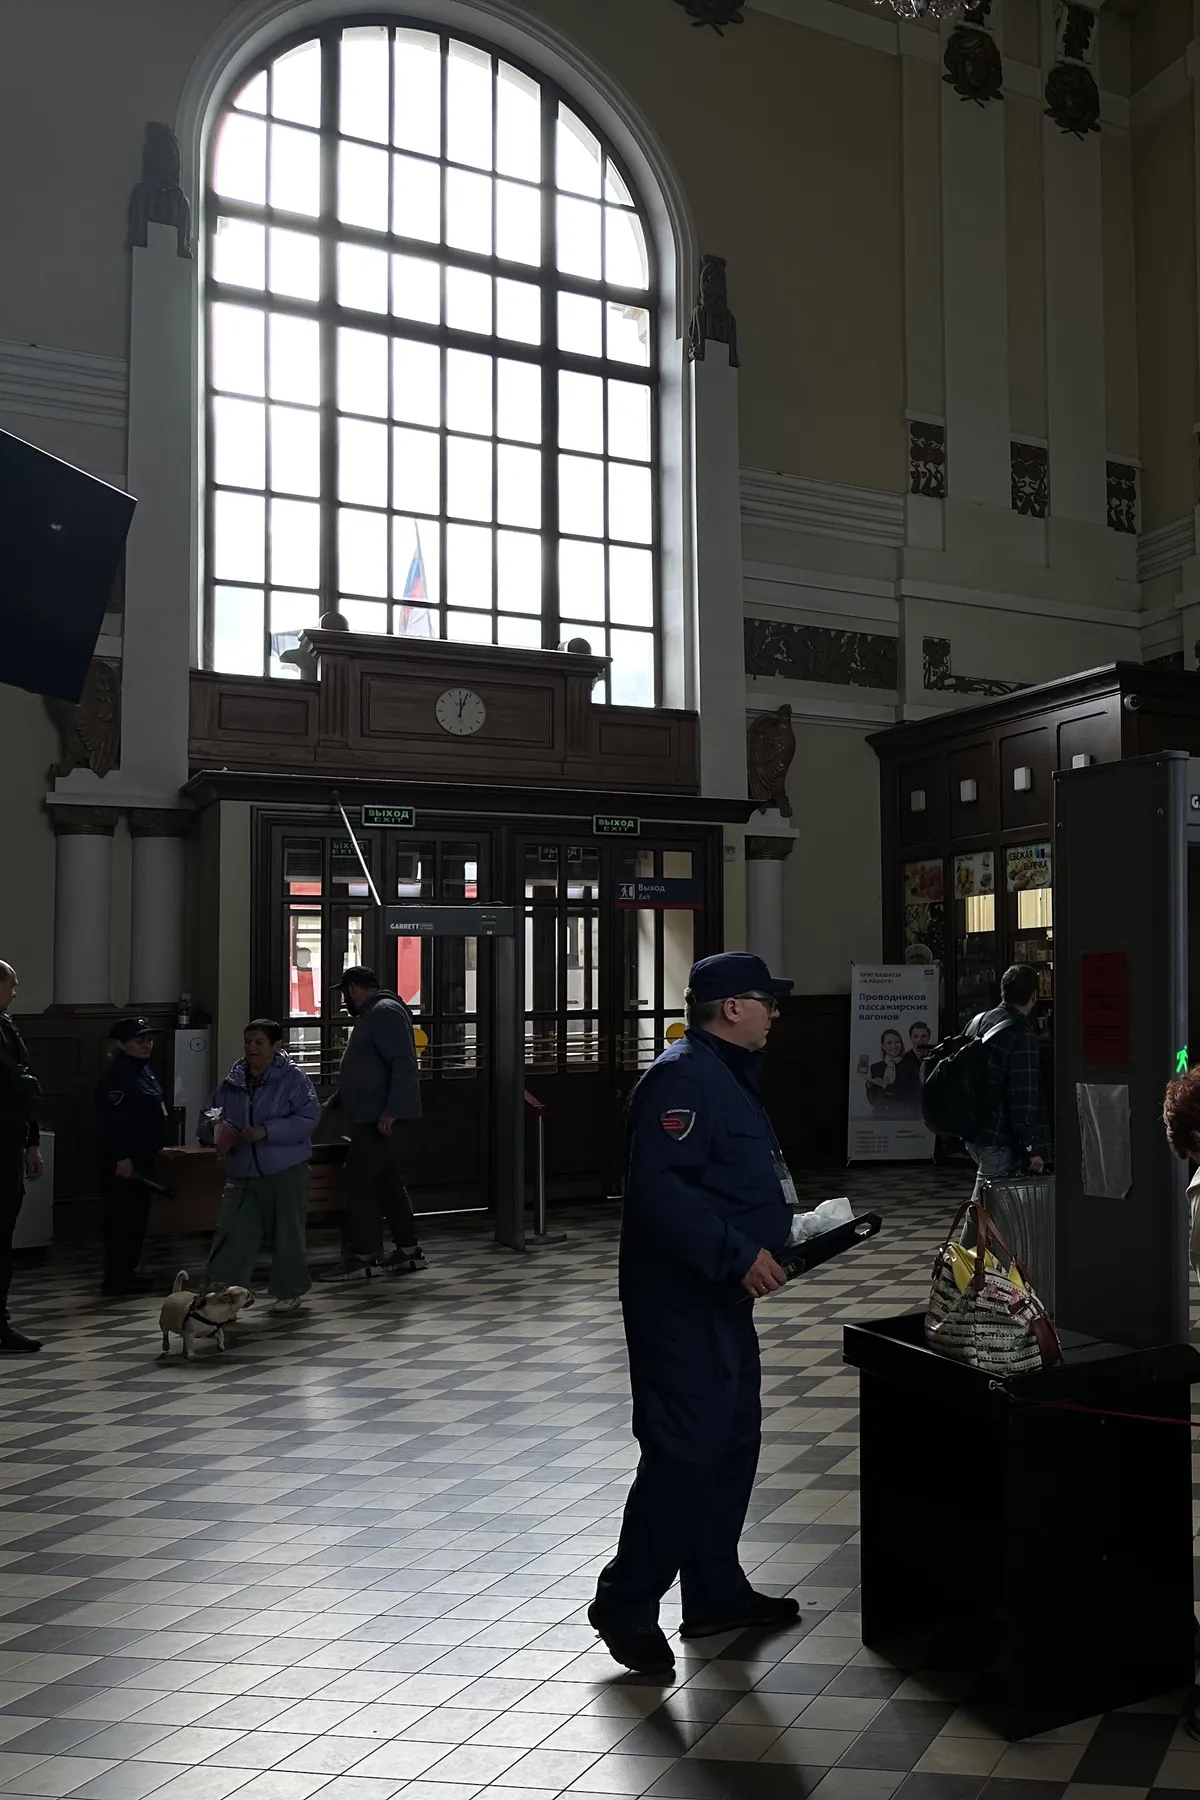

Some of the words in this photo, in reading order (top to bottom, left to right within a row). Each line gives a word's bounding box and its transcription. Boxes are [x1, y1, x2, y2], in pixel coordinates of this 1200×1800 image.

[368, 809, 410, 819] ВЫХОД
[598, 818, 635, 828] ВЫХОД
[1009, 850, 1033, 862] СВЕЖАЯ
[1023, 860, 1048, 871] ВЫПЕЧКА
[637, 883, 666, 893] Выход
[859, 993, 926, 1003] Проводников
[858, 1004, 928, 1013] пассажирских
